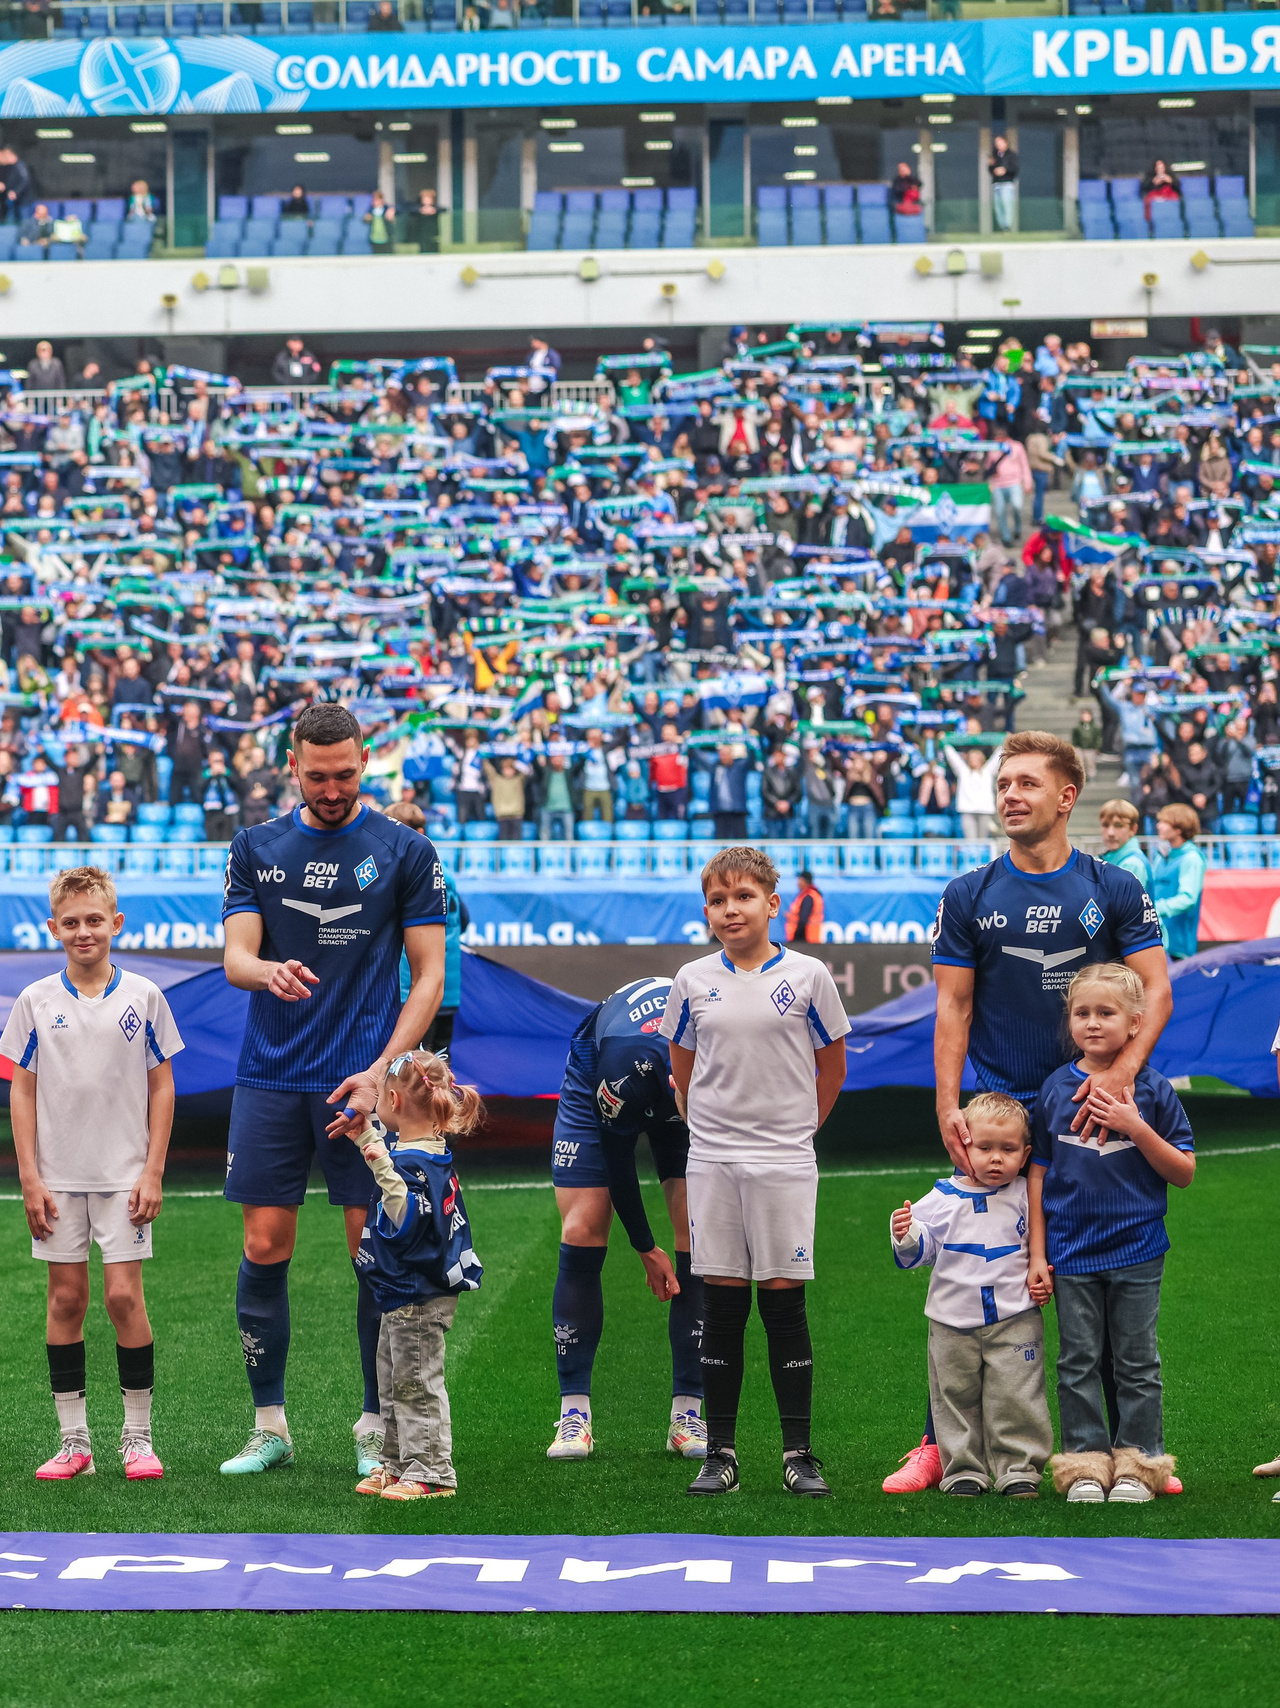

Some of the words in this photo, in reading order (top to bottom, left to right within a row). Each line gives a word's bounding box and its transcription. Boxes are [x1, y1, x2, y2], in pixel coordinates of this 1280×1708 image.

[1033, 25, 1280, 79] КРЫЛЬЯ
[276, 49, 622, 91] СОЛИДАРНОСТЬ
[637, 44, 818, 83] САМАРА
[830, 41, 967, 79] АРЕНА
[257, 865, 287, 884] wb
[304, 861, 341, 876] FON
[433, 863, 444, 875] FO
[303, 875, 339, 889] BET
[434, 876, 447, 889] BE
[1025, 905, 1062, 919] FON
[1143, 909, 1157, 924] BE
[976, 910, 1008, 931] wb
[1025, 919, 1062, 933] BET
[318, 927, 371, 936] ПРАВИТЕЛЬСТВО
[318, 933, 357, 941] САМАРСКОЙ
[1042, 971, 1077, 979] ПРАВИТЕЛ
[554, 1140, 580, 1155] FON
[554, 1154, 577, 1168] BET
[557, 1344, 567, 1356] 15
[1024, 1348, 1035, 1361] 08
